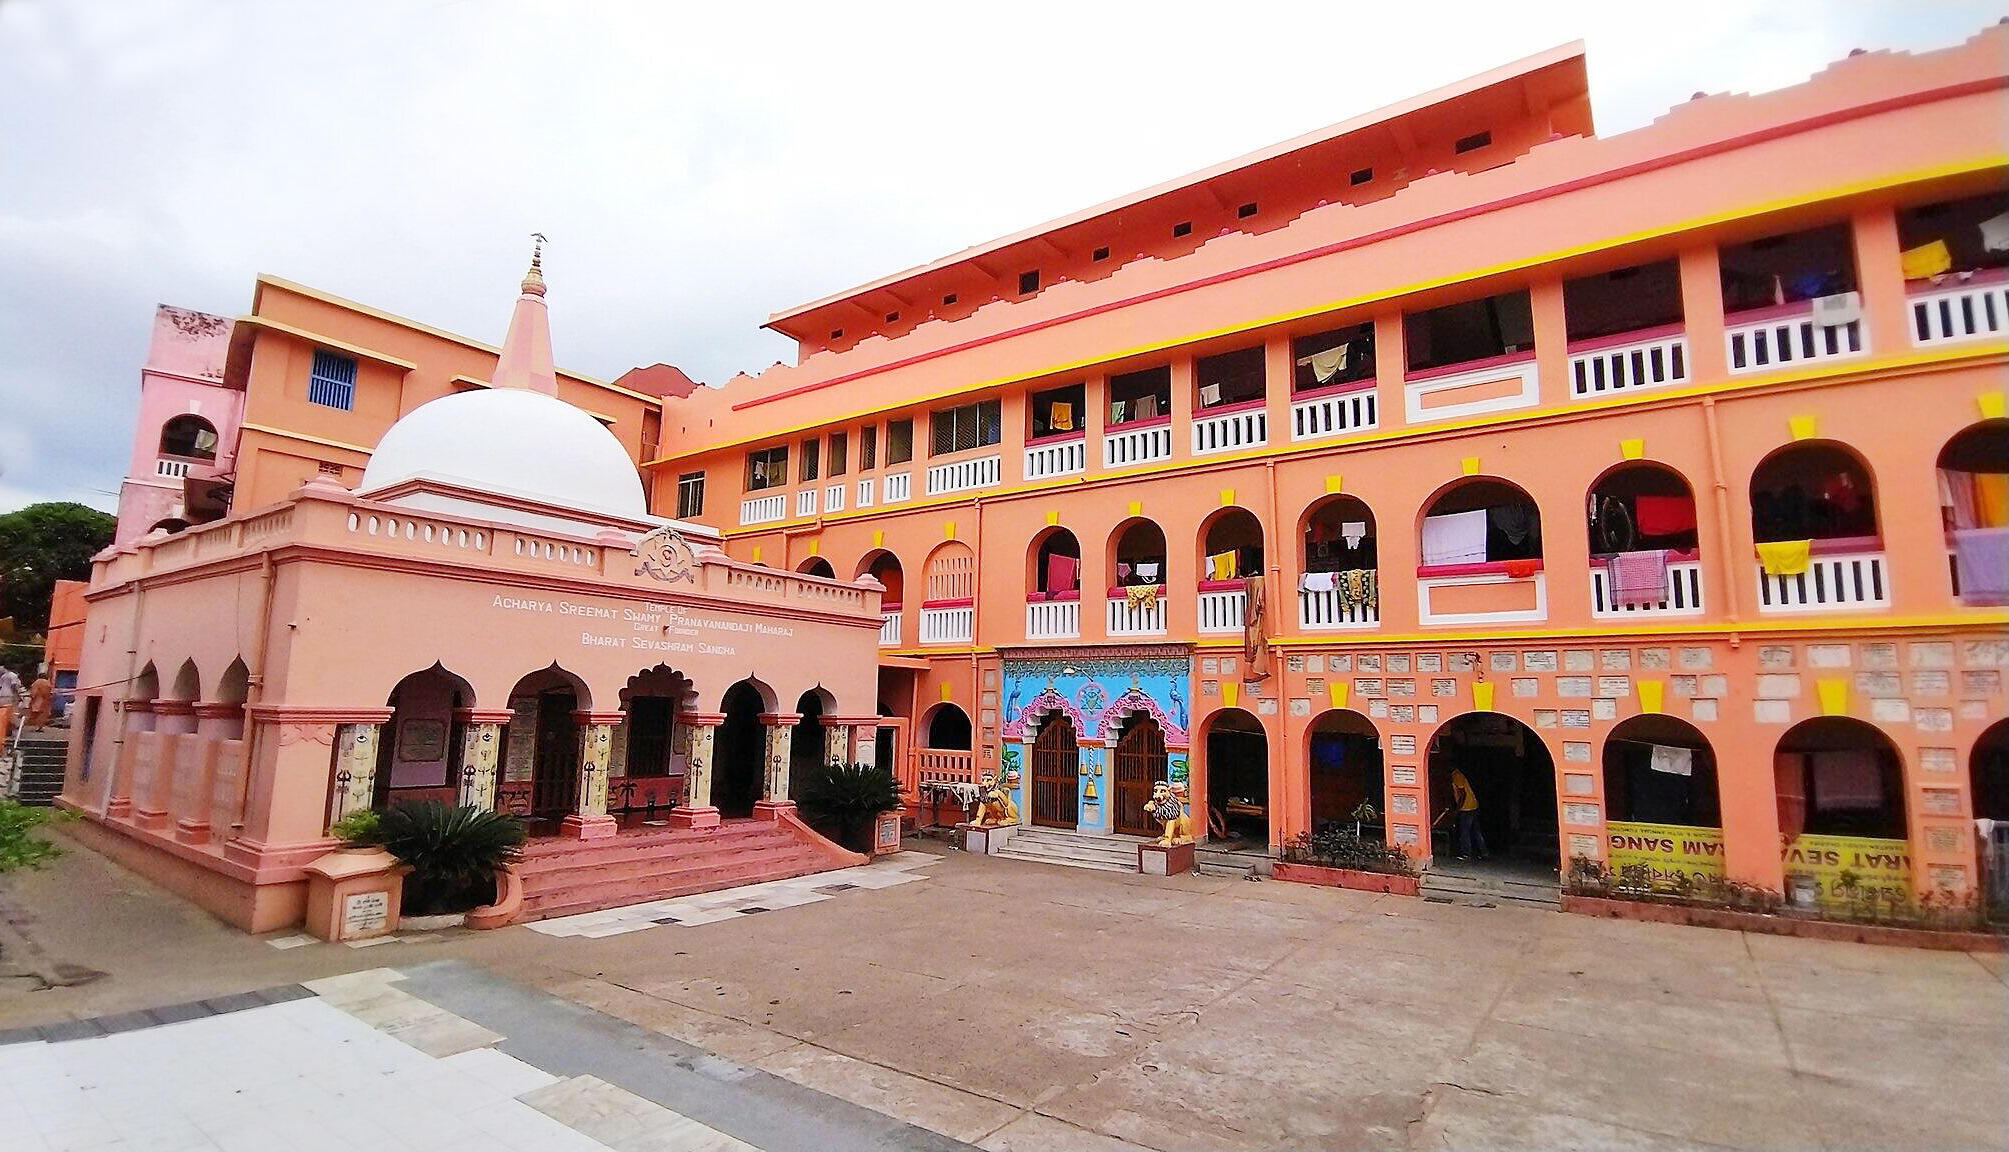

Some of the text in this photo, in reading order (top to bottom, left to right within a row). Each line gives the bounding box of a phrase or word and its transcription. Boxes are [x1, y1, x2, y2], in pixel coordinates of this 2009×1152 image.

[492, 594, 553, 613] ACHARYA
[559, 601, 619, 619] SREEMAT
[623, 608, 661, 623] SWAMY
[755, 623, 793, 637] MAHARAJ
[644, 601, 675, 614] TEMPLE
[581, 632, 736, 656] BHARAT SEVASHRAM SANGHA
[1607, 834, 1674, 854] SANG
